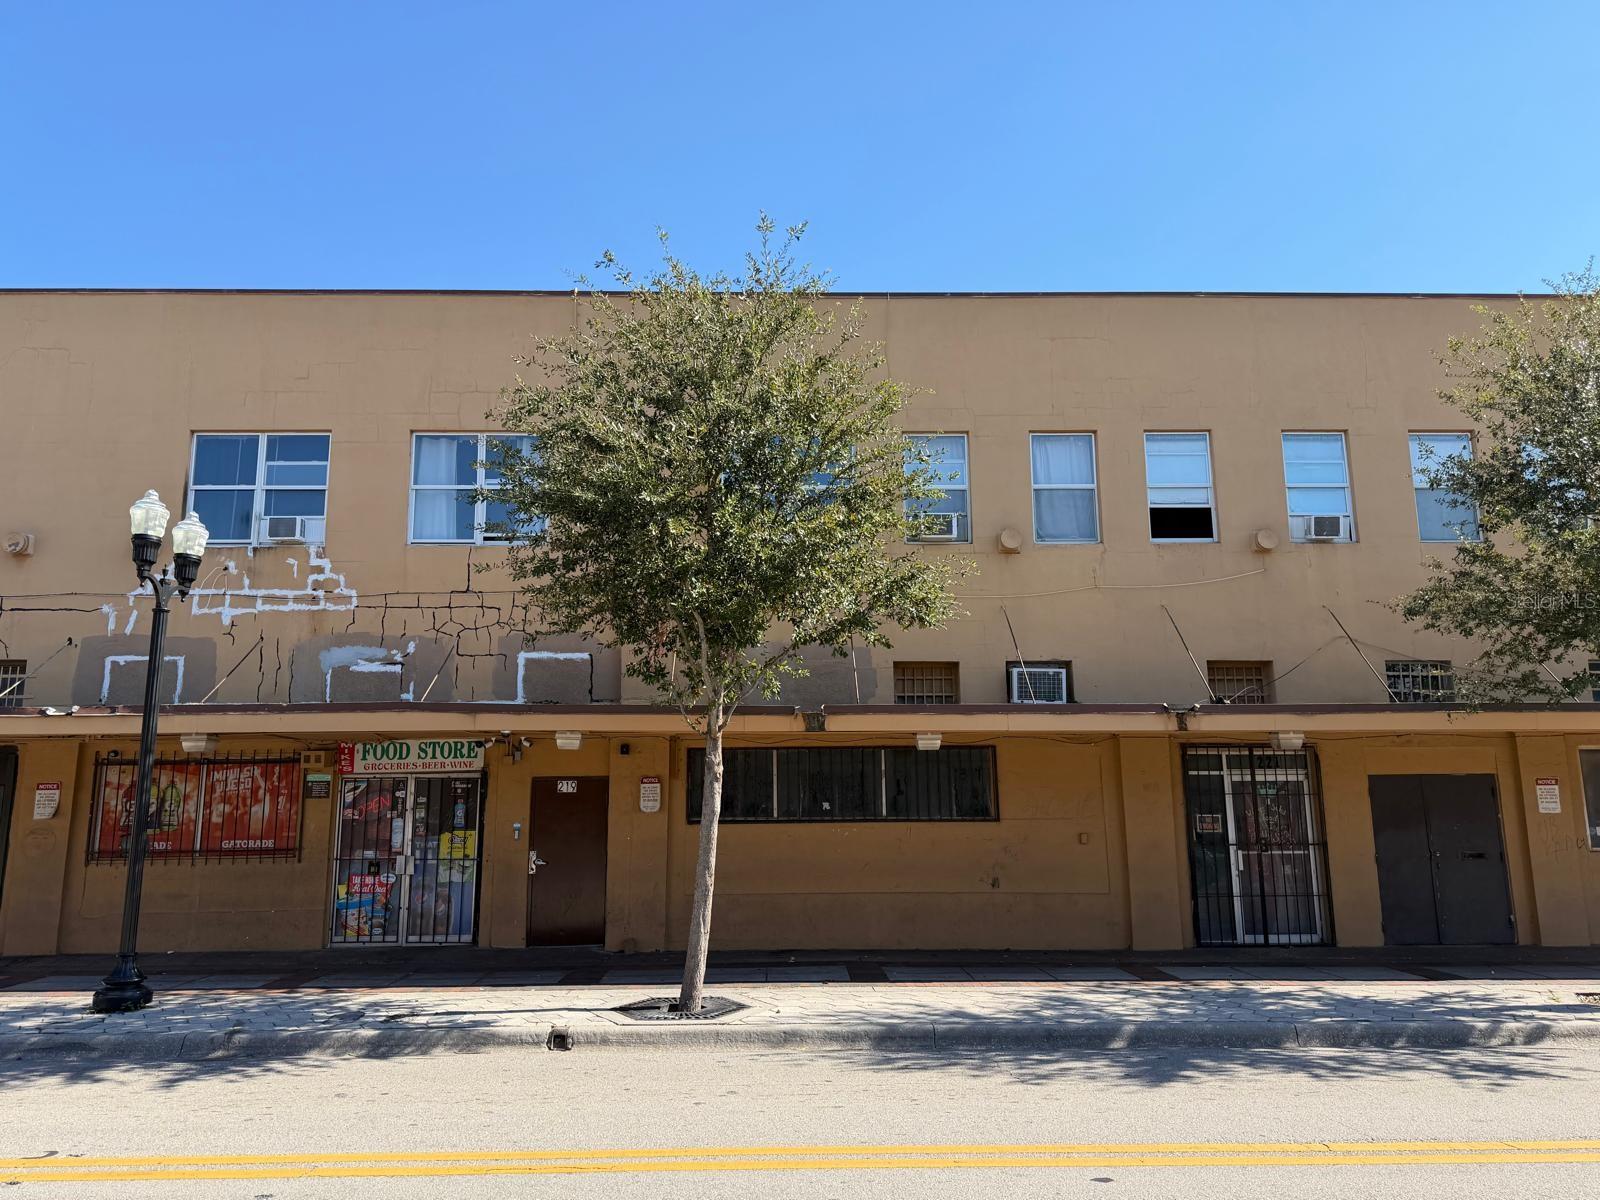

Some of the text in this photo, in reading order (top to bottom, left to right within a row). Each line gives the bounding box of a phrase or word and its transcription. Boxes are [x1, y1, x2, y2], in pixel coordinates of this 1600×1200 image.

[360, 740, 478, 761] FOOD STORE
[558, 781, 577, 792] 219
[221, 839, 274, 849] GATORADE
